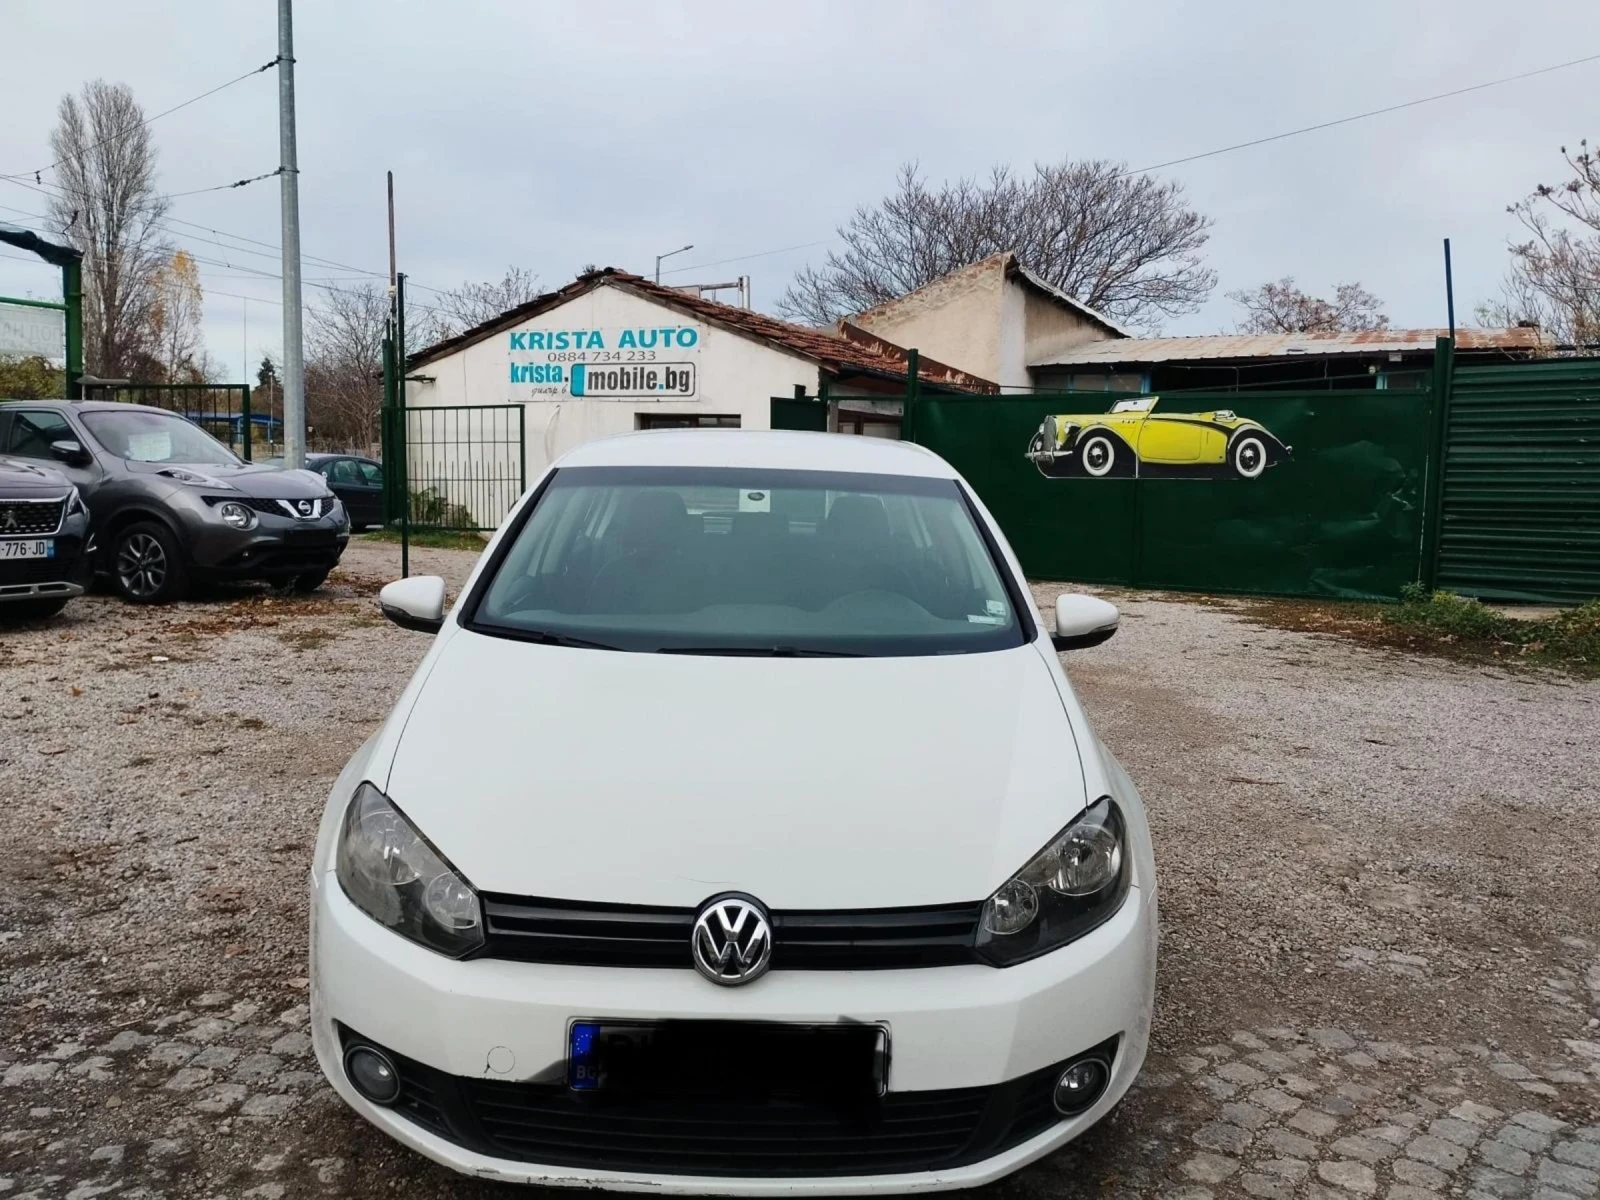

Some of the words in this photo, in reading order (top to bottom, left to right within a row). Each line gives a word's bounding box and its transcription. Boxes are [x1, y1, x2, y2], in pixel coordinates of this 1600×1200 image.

[510, 331, 605, 350] KRISTA
[618, 328, 698, 348] AUTO
[547, 351, 586, 362] 0884
[593, 351, 621, 361] 734
[627, 350, 656, 361] 233
[587, 366, 690, 393] mobile.bg
